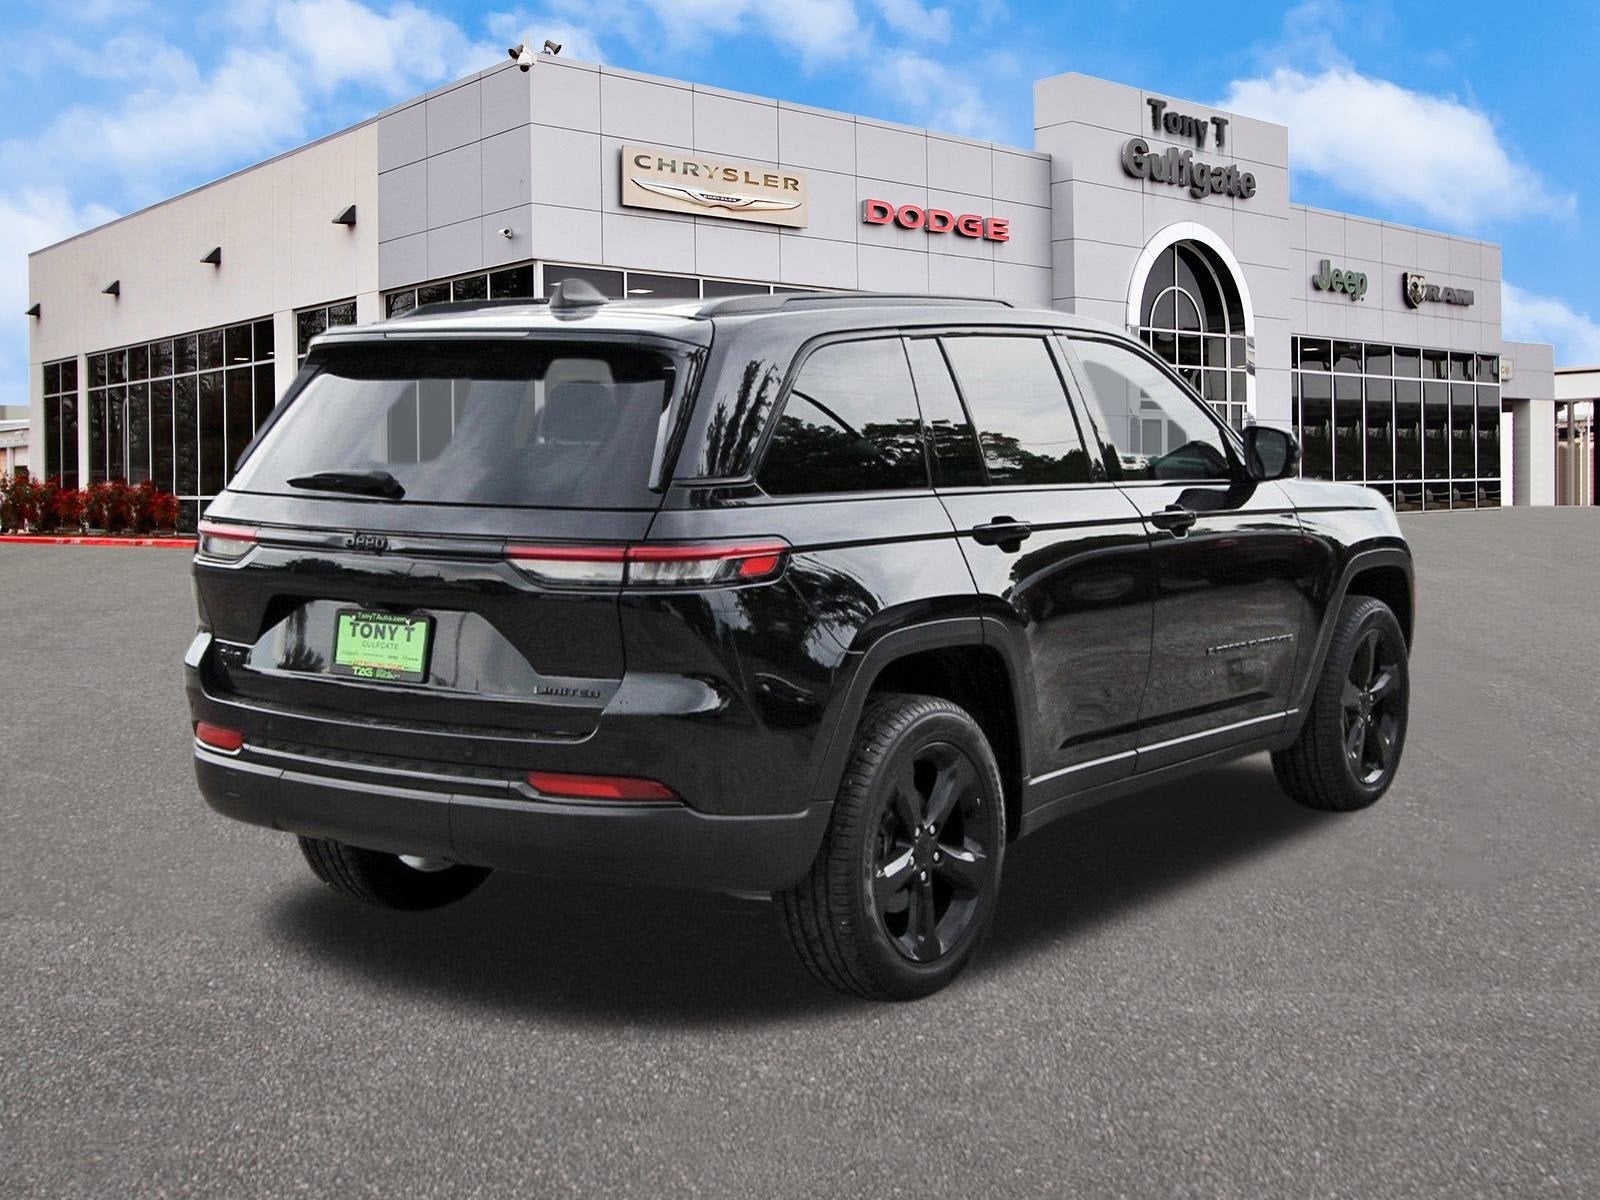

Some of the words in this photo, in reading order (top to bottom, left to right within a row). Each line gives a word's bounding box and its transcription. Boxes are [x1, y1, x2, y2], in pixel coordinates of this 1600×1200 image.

[1146, 98, 1208, 147] Tony
[1210, 116, 1229, 147] T
[634, 154, 799, 192] CHRYSLER
[1121, 138, 1256, 199] Gulfgate
[862, 198, 1010, 242] DODGE
[1312, 259, 1368, 302] Jeep
[1424, 283, 1474, 306] RAM
[344, 530, 388, 556] Jeep
[350, 621, 398, 641] TONY
[404, 626, 416, 642] T
[533, 685, 600, 699] LIMITED
